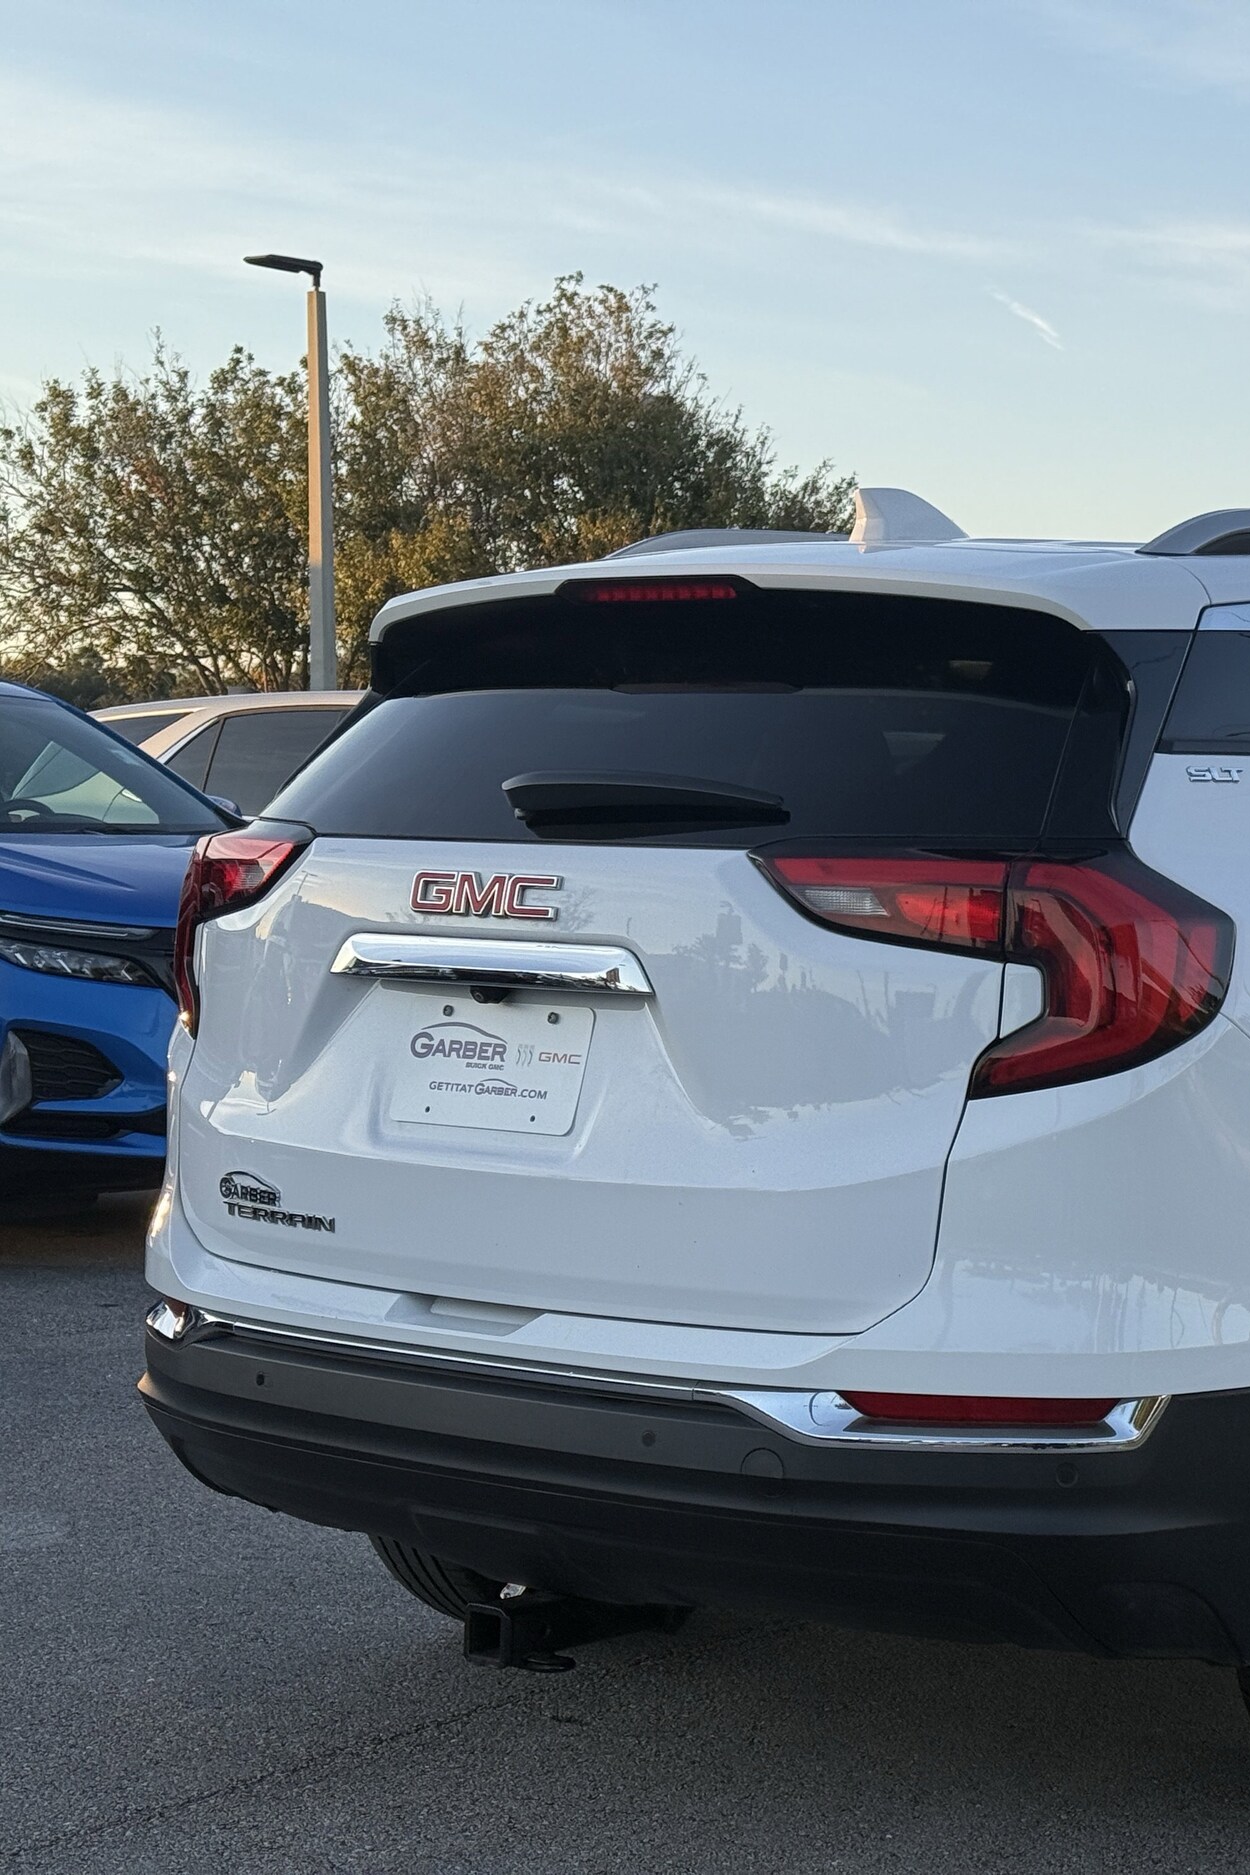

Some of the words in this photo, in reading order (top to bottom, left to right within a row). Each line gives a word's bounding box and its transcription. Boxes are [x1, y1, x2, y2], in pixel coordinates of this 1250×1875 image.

[1186, 766, 1243, 783] SLT
[410, 869, 564, 921] GMC
[410, 1031, 508, 1062] GARBER
[538, 1051, 582, 1065] GMC
[220, 1176, 281, 1207] GARBER
[223, 1201, 336, 1233] TERRAIN
